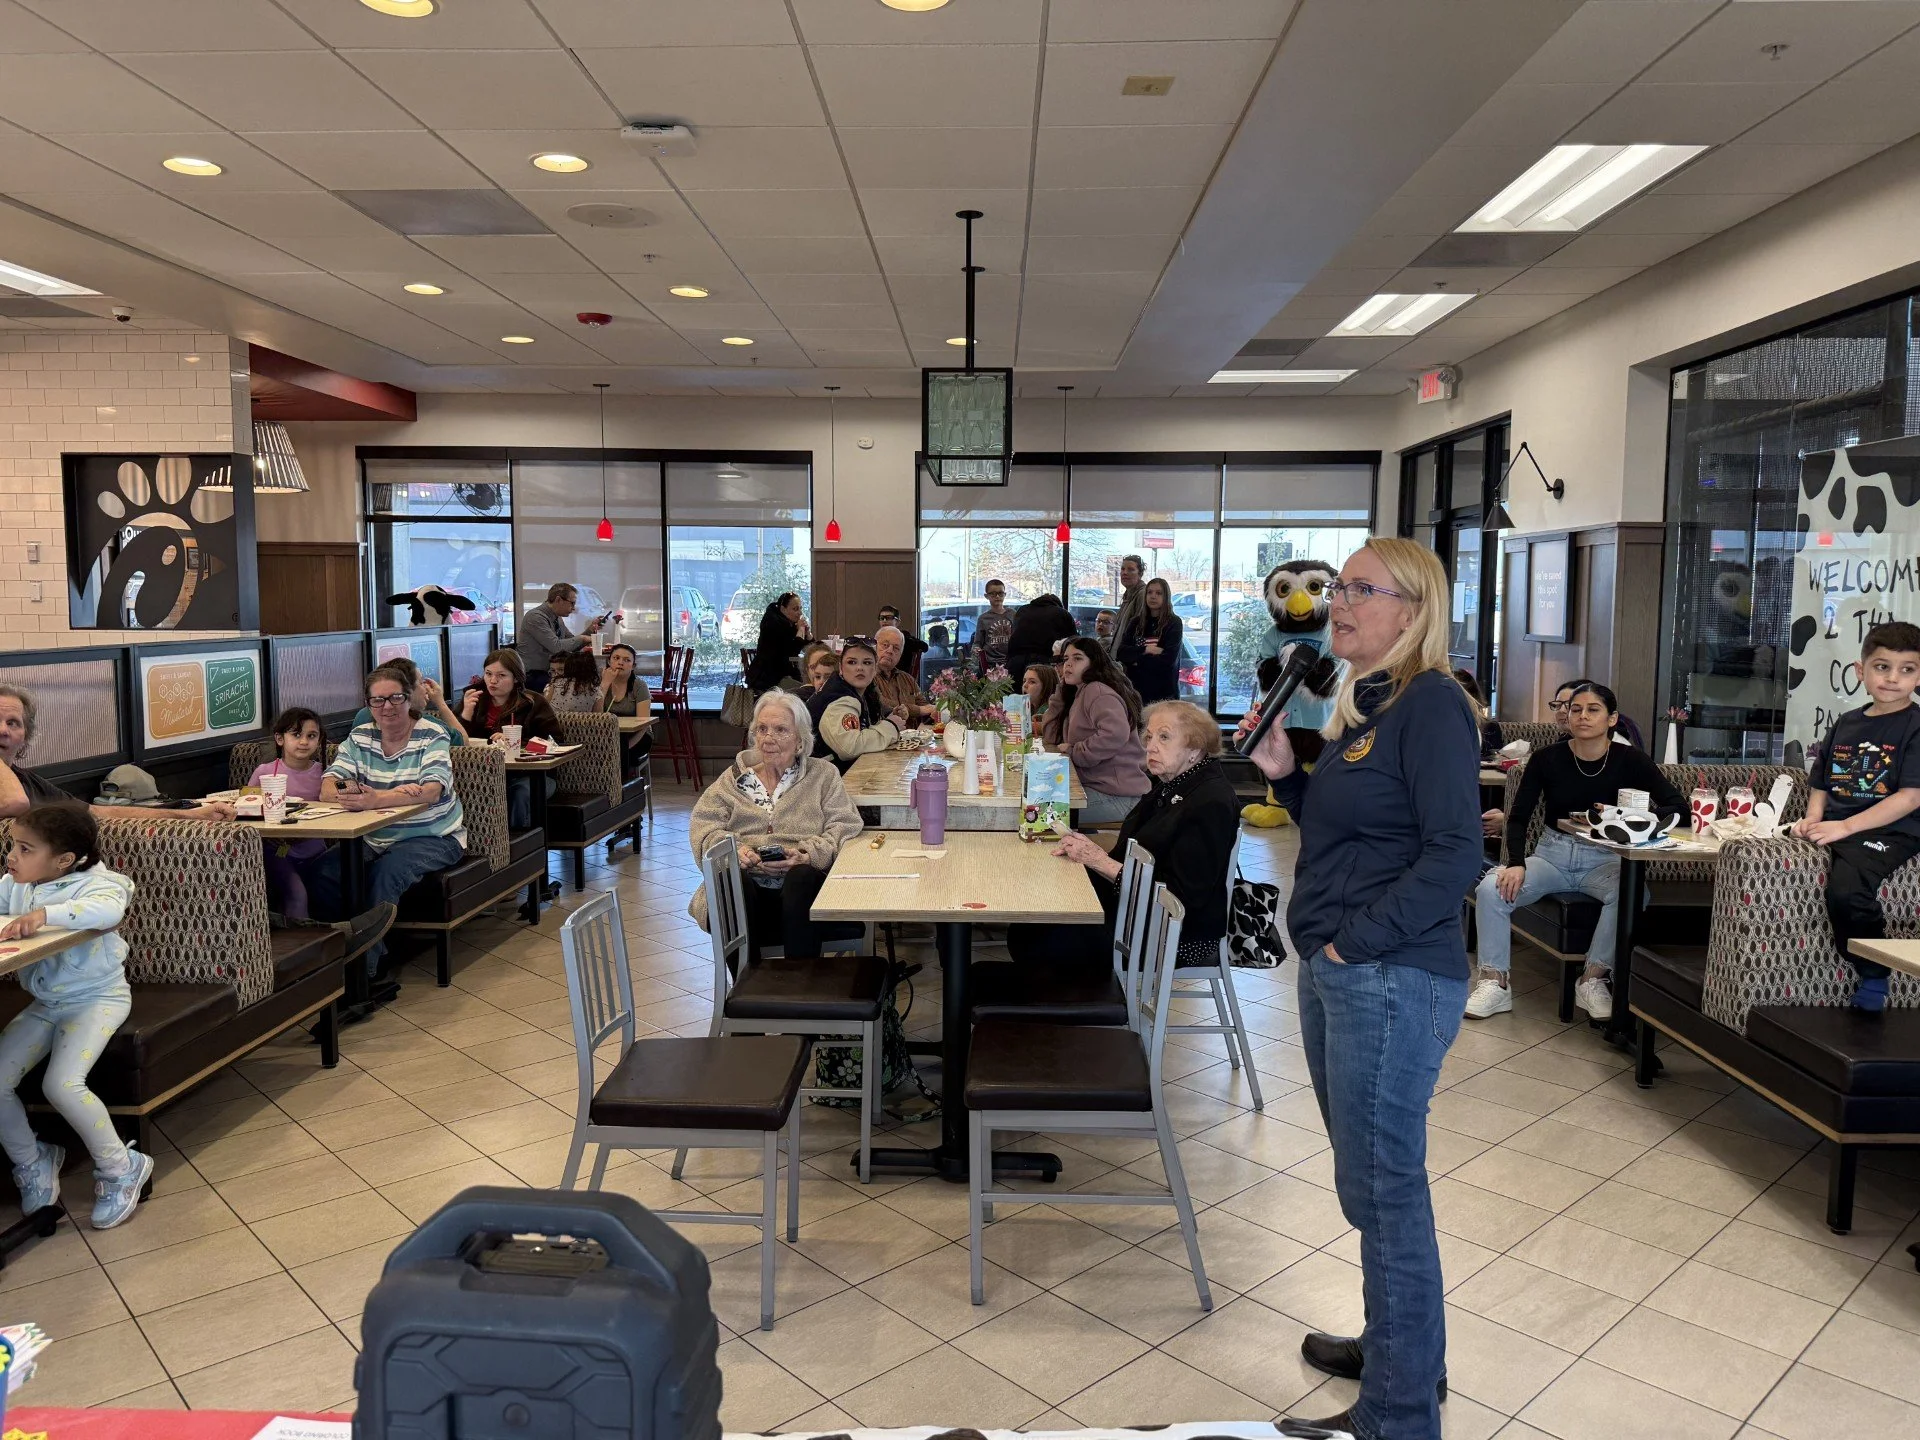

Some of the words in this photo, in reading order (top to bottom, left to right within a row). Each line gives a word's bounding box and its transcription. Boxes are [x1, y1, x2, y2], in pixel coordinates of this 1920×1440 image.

[1824, 606, 1839, 640] 2
[1853, 608, 1894, 644] TH
[215, 679, 249, 706] SRIRACHA
